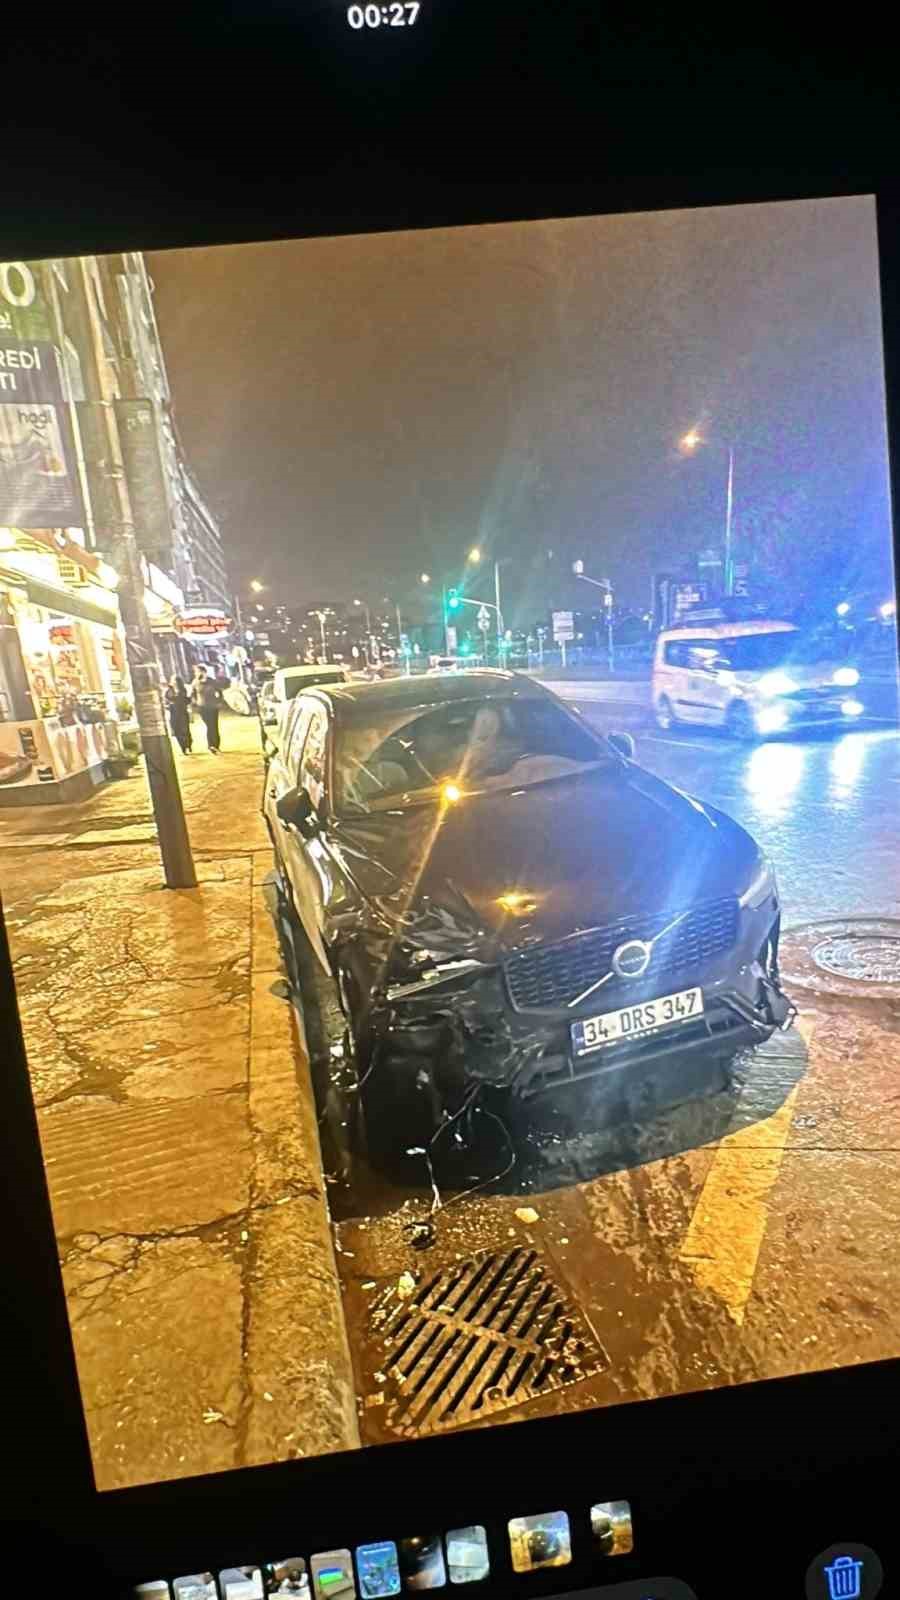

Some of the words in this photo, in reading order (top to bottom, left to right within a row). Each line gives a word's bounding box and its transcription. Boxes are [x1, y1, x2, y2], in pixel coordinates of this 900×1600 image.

[347, 1, 420, 29] 00:27
[584, 1018, 610, 1043] 34
[619, 1005, 657, 1032] DRS
[661, 992, 697, 1020] 347
